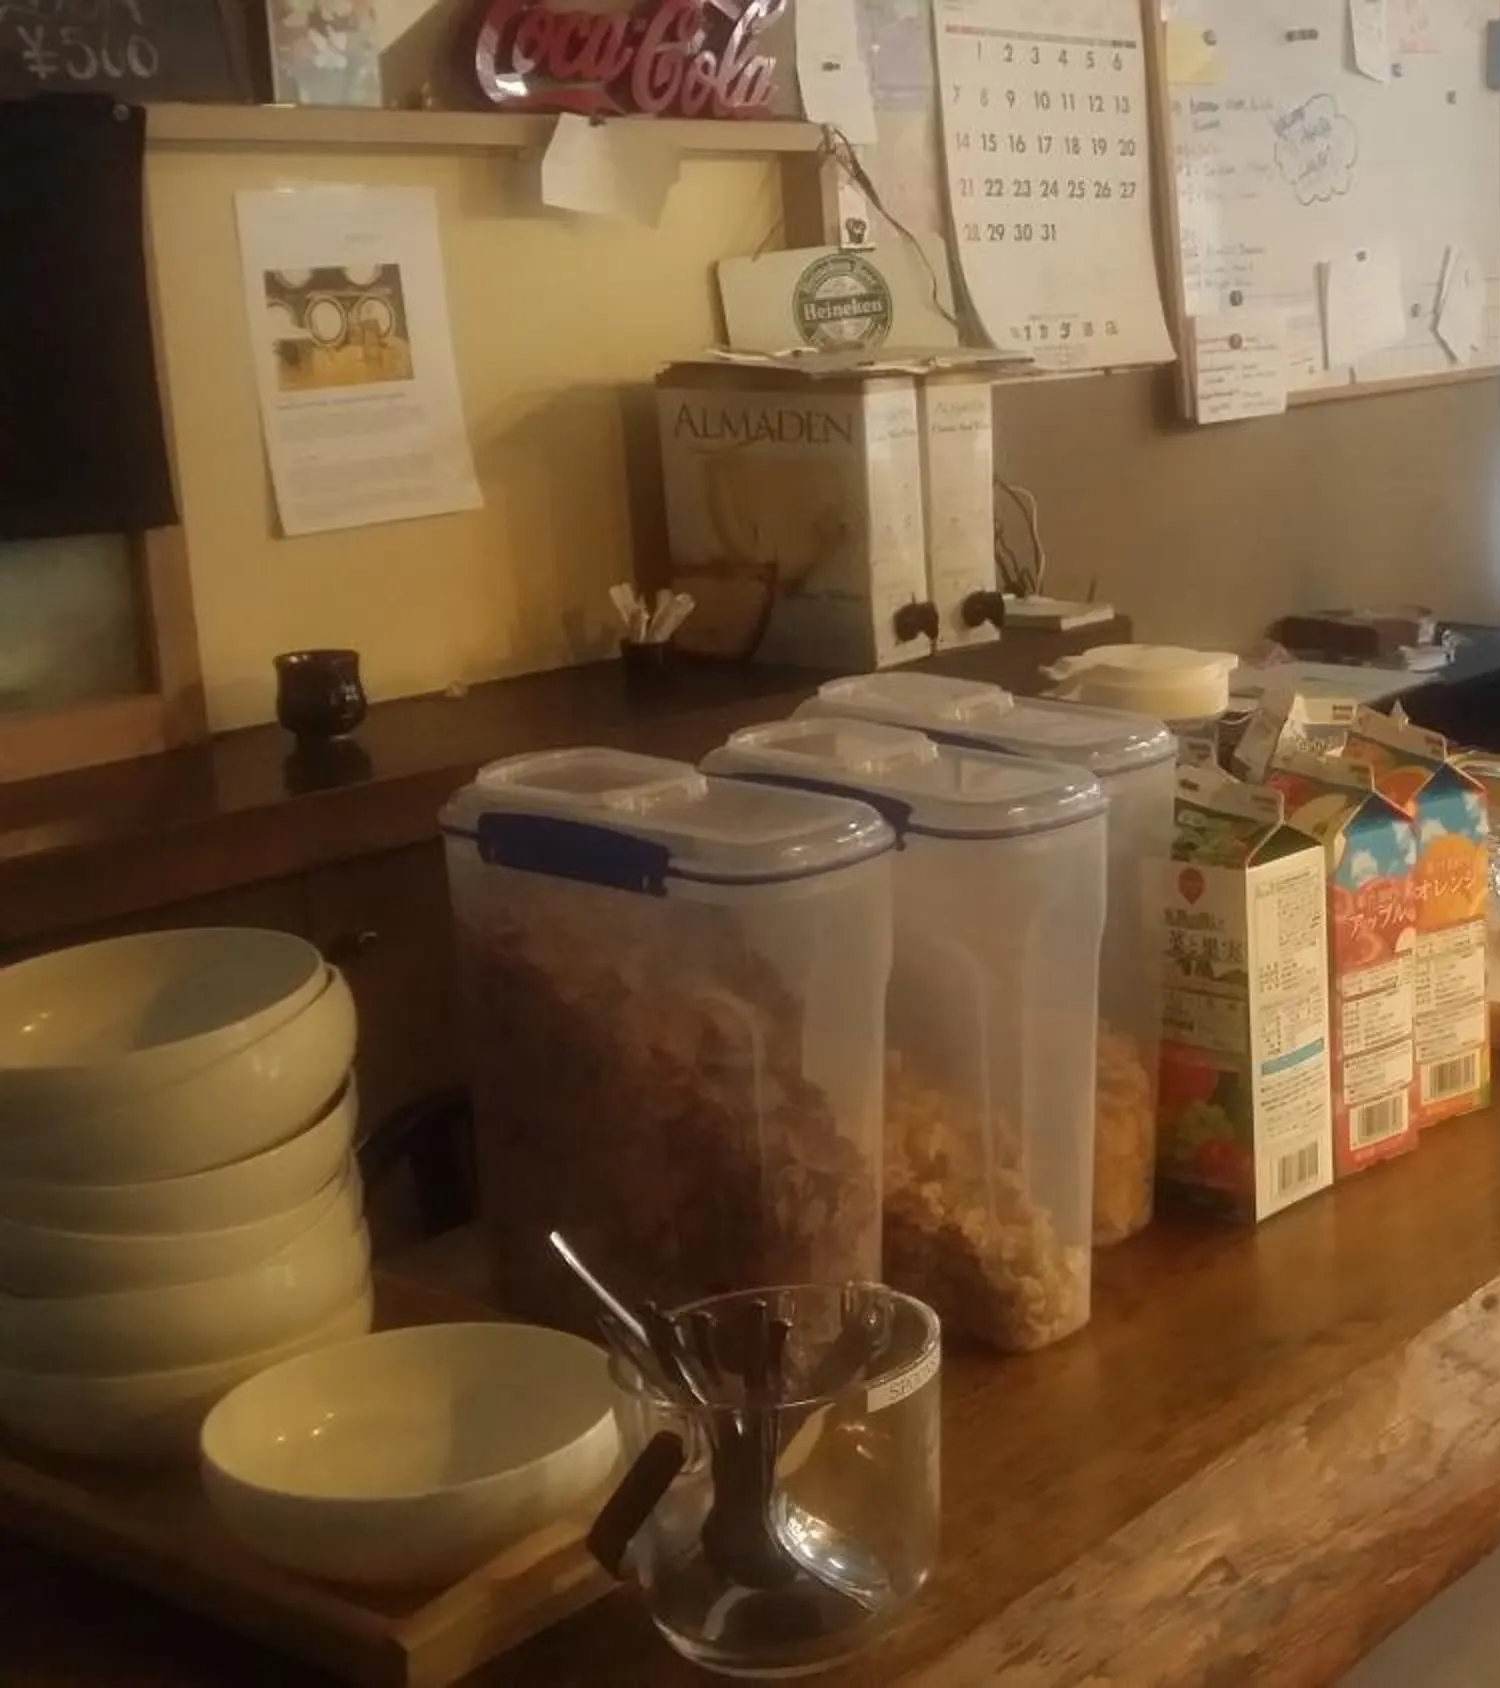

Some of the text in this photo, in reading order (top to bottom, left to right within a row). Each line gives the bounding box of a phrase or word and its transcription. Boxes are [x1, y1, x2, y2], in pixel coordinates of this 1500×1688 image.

[475, 0, 787, 117] Coca-Cola
[1003, 43, 1013, 62] 2
[1030, 46, 1040, 64] 3
[1058, 49, 1068, 66] 4
[1086, 51, 1095, 68] 5
[1112, 53, 1122, 71] 6
[1005, 89, 1015, 109] 9
[1034, 90, 1050, 110] 10
[1061, 92, 1075, 111] 11
[1089, 95, 1104, 113] 12
[1115, 96, 1130, 114] 13
[956, 132, 1136, 156] 14 15 16 17 18 19 20
[959, 178, 1136, 199] 21 22 23 24 25 26 27
[987, 223, 1005, 241] 29
[1014, 223, 1033, 241] 30
[1041, 223, 1057, 241] 31
[804, 298, 883, 320] Heineken
[674, 403, 853, 444] ALMADEN
